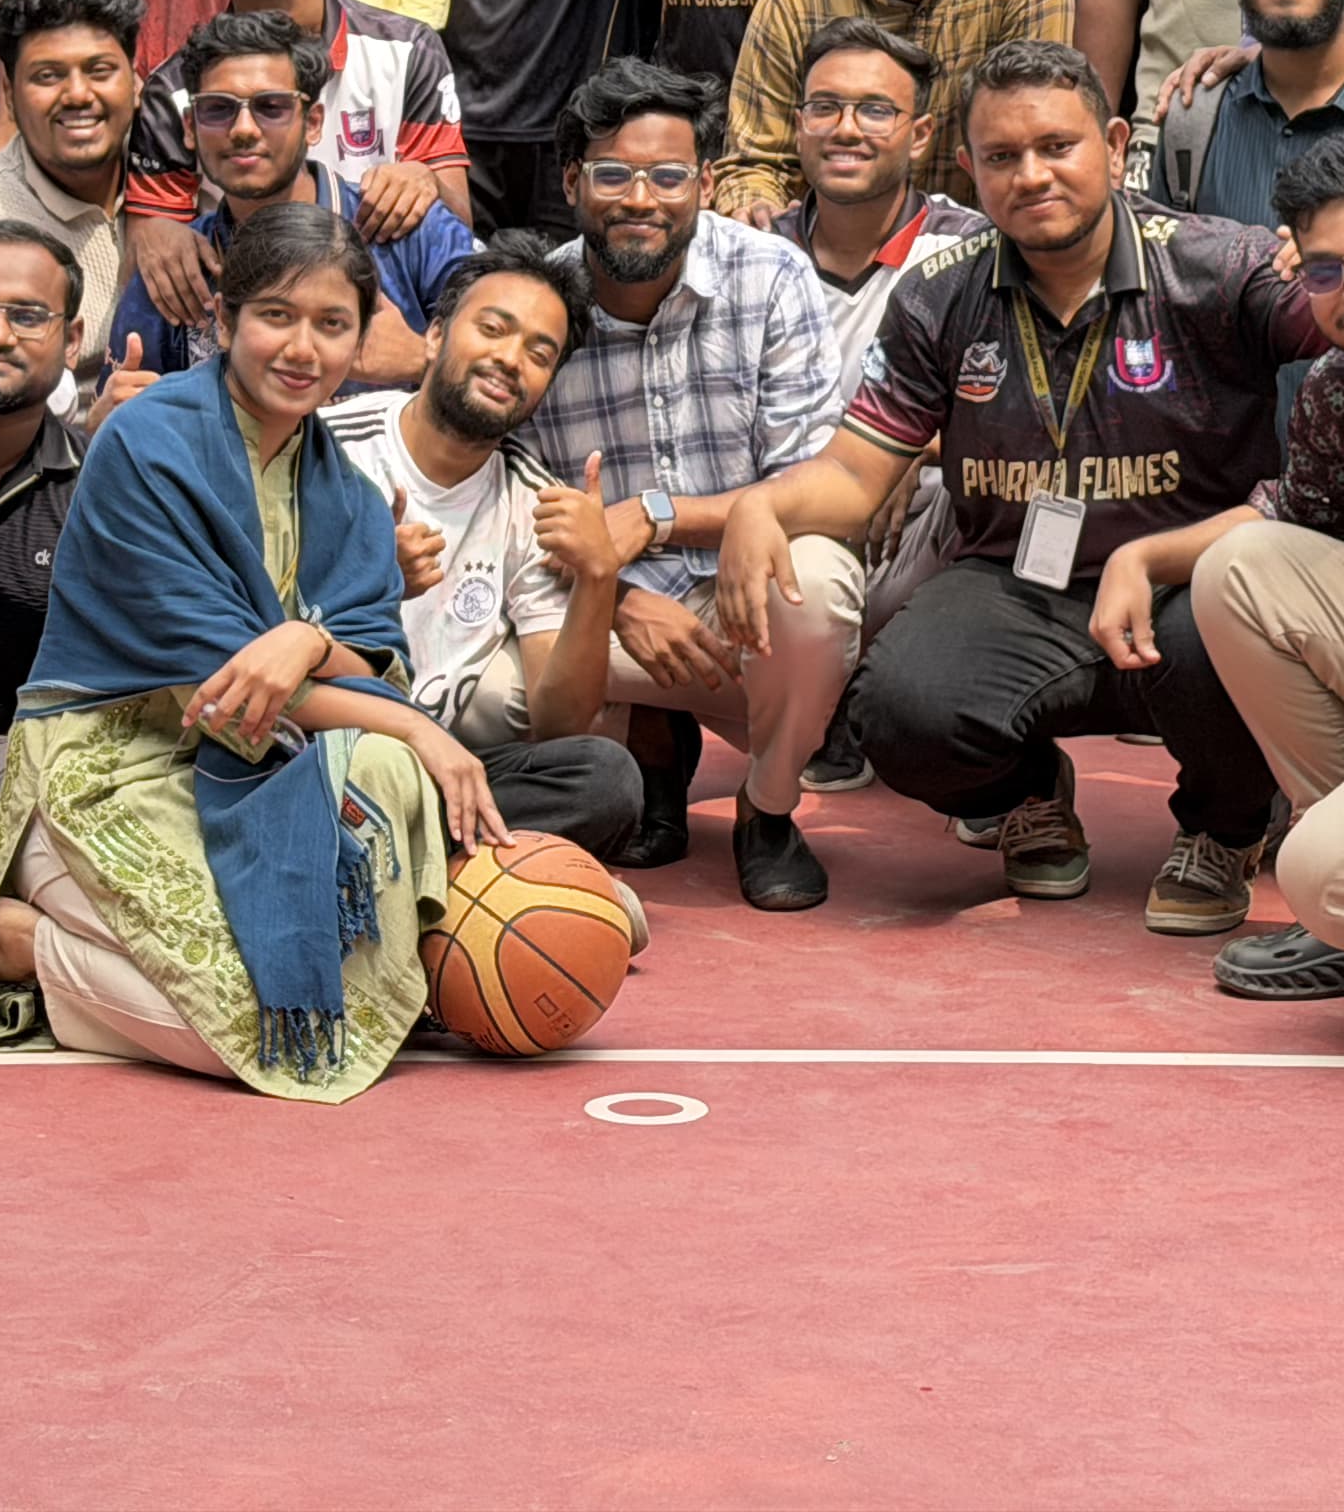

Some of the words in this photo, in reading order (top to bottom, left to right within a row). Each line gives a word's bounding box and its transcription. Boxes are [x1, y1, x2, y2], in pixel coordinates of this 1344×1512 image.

[922, 228, 999, 280] BATCH
[962, 457, 1068, 503] PHARMA
[1077, 450, 1181, 500] FLAMES
